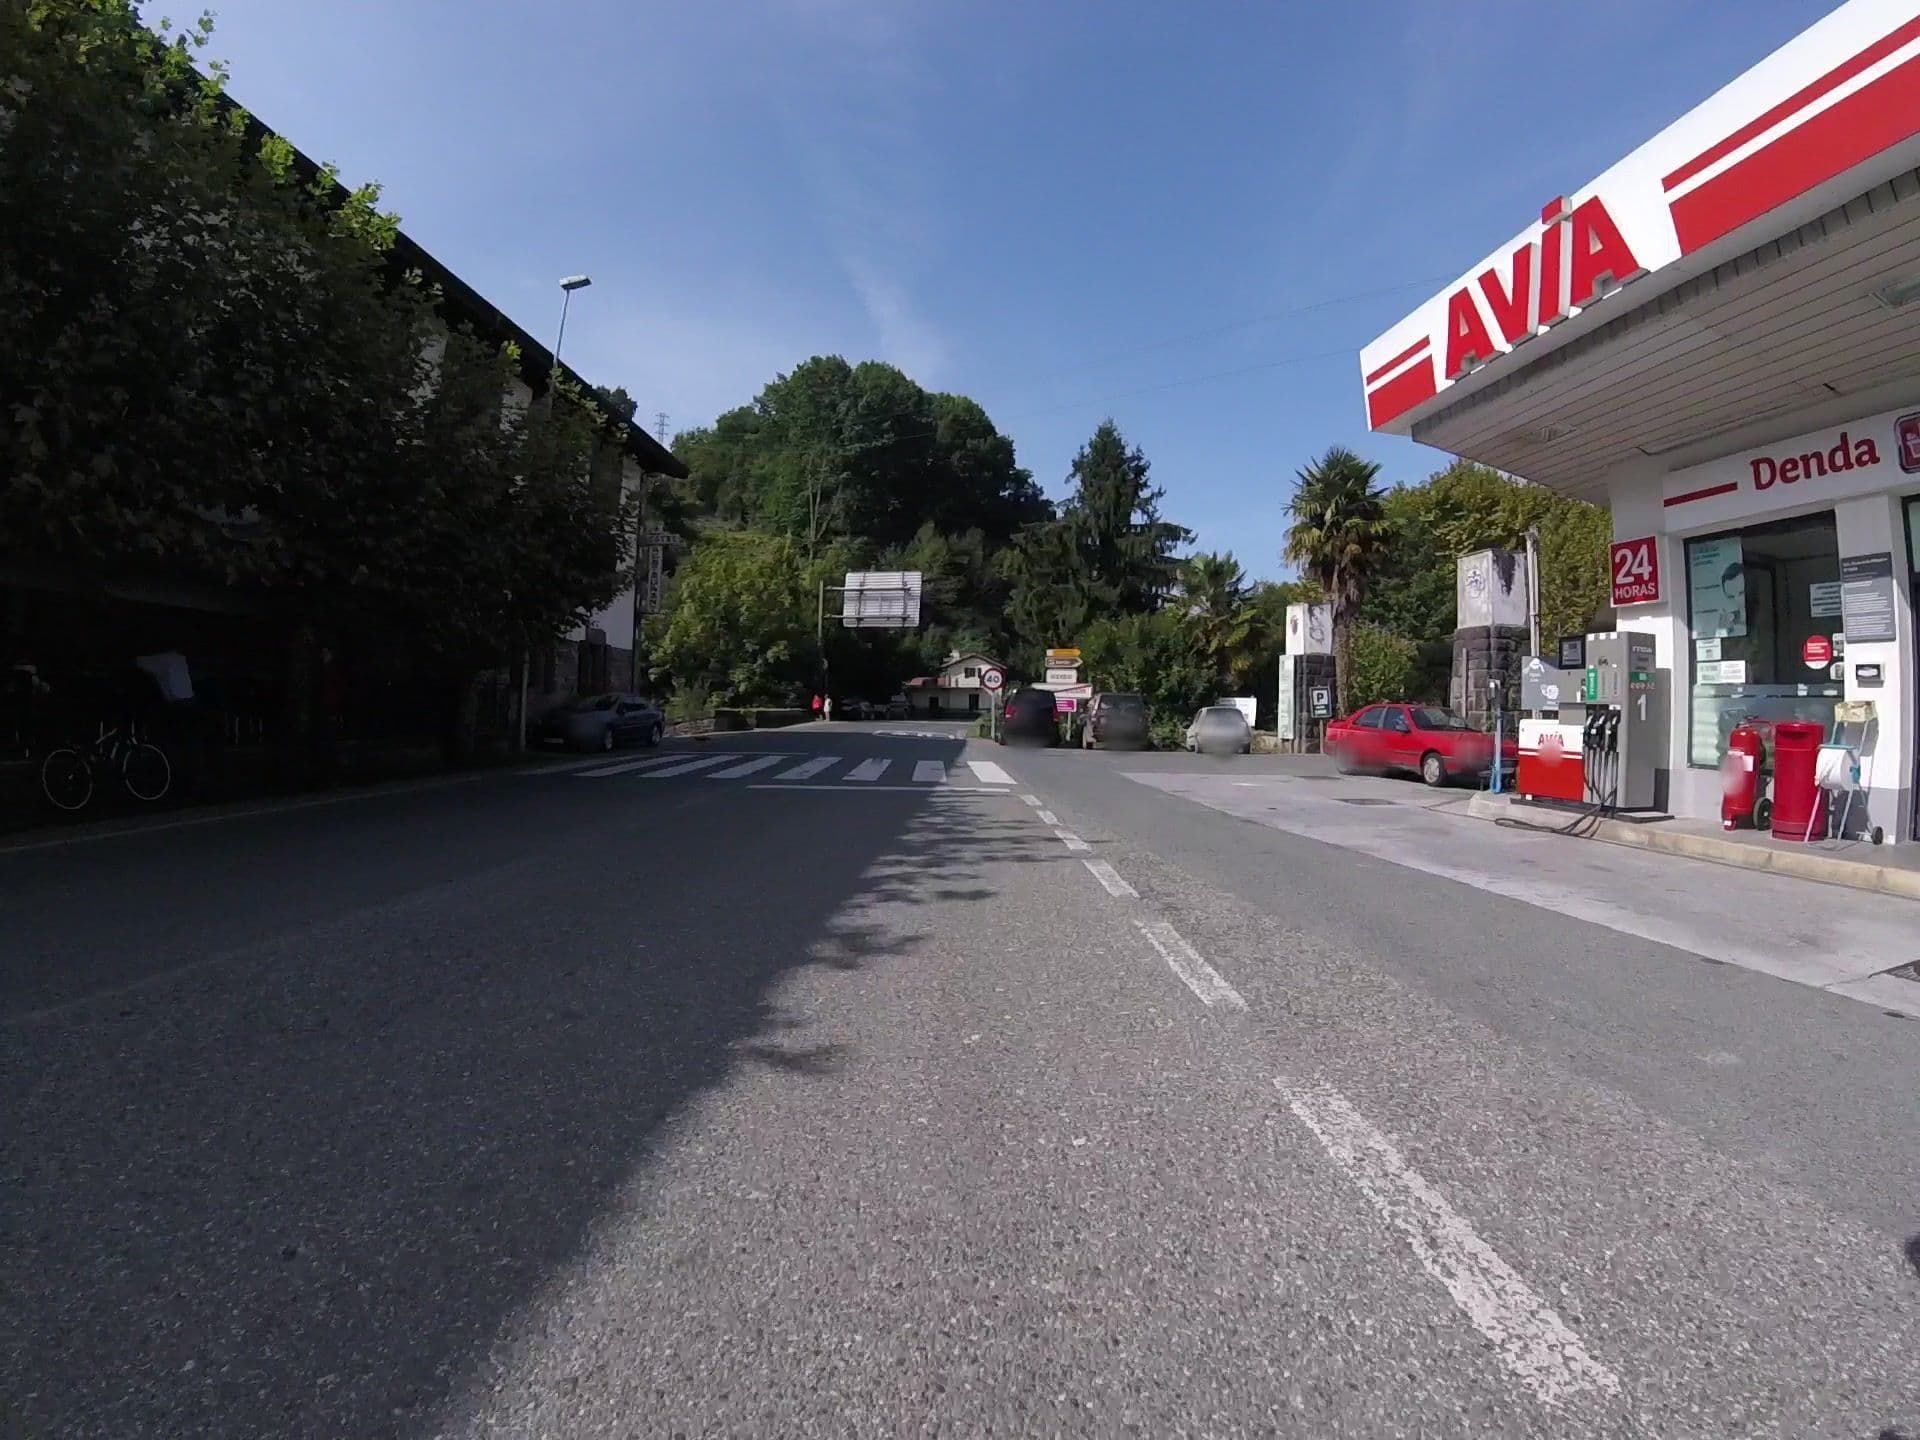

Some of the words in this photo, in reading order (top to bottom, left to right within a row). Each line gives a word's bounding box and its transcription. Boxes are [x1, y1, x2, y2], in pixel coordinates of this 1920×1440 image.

[1751, 432, 1880, 491] Denda
[1615, 544, 1652, 584] 24
[1615, 583, 1656, 600] HORAS
[986, 675, 999, 683] 40
[1317, 693, 1324, 703] P
[1637, 694, 1647, 721] 1
